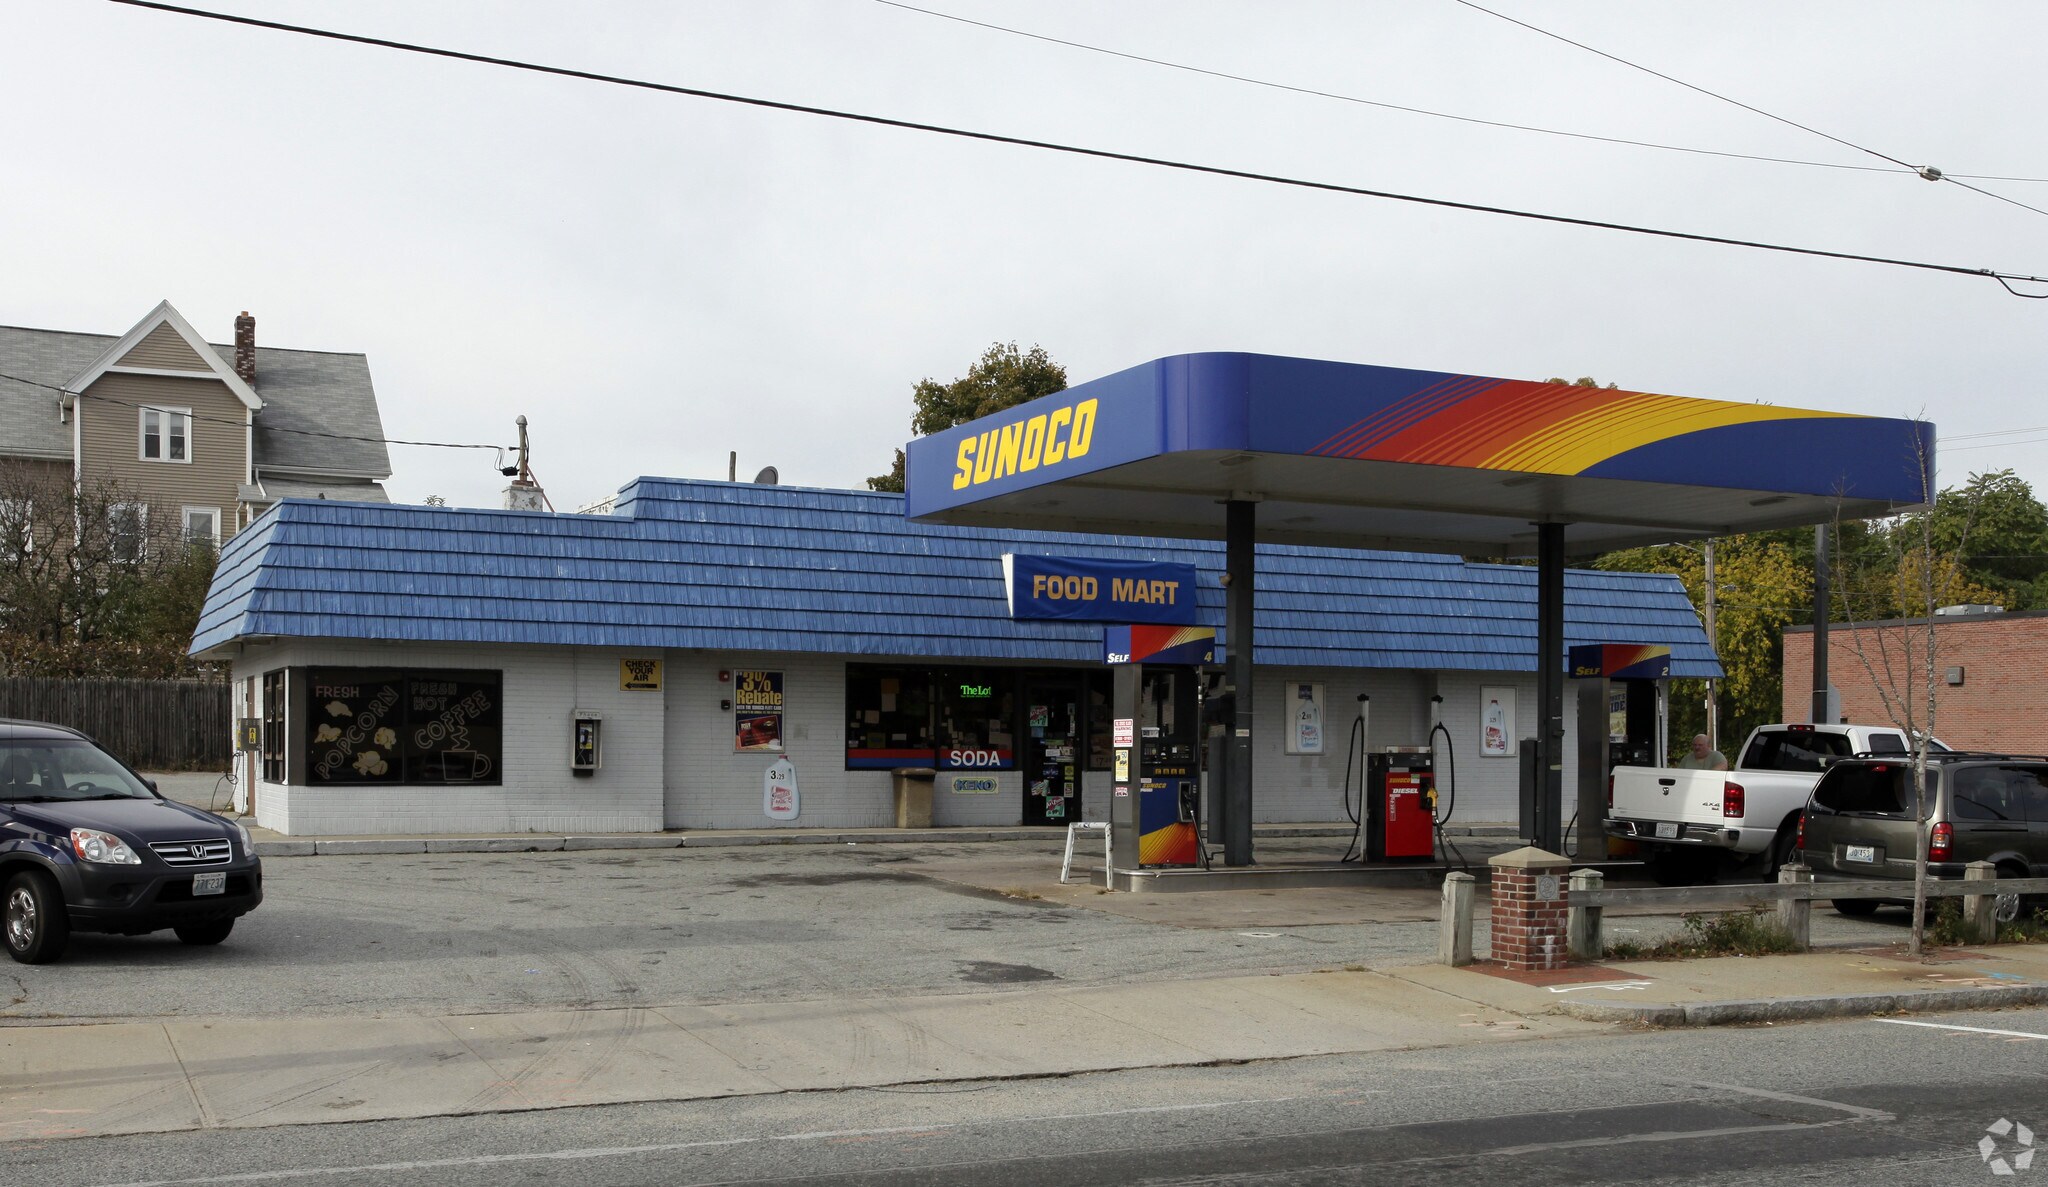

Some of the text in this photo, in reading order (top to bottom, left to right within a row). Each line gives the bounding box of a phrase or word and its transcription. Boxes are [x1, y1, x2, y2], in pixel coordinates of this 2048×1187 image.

[952, 397, 1099, 491] SUNOCO
[1032, 574, 1179, 606] FOOD MART
[1106, 652, 1130, 663] SELF
[1203, 651, 1213, 662] 4
[625, 660, 657, 668] CHECK
[629, 667, 654, 675] YOUR
[1575, 666, 1601, 676] SELF
[1661, 666, 1669, 676] 2
[742, 671, 772, 692] 3%
[314, 684, 360, 698] FRESH
[410, 682, 458, 695] FRESH
[960, 685, 977, 695] The
[413, 696, 448, 711] HOT
[736, 689, 782, 705] Rebate
[414, 690, 492, 749] COFFEE
[314, 685, 400, 779] POPCORN
[950, 750, 1001, 766] SODA
[770, 770, 785, 780] 3.29
[957, 780, 993, 791] KENO
